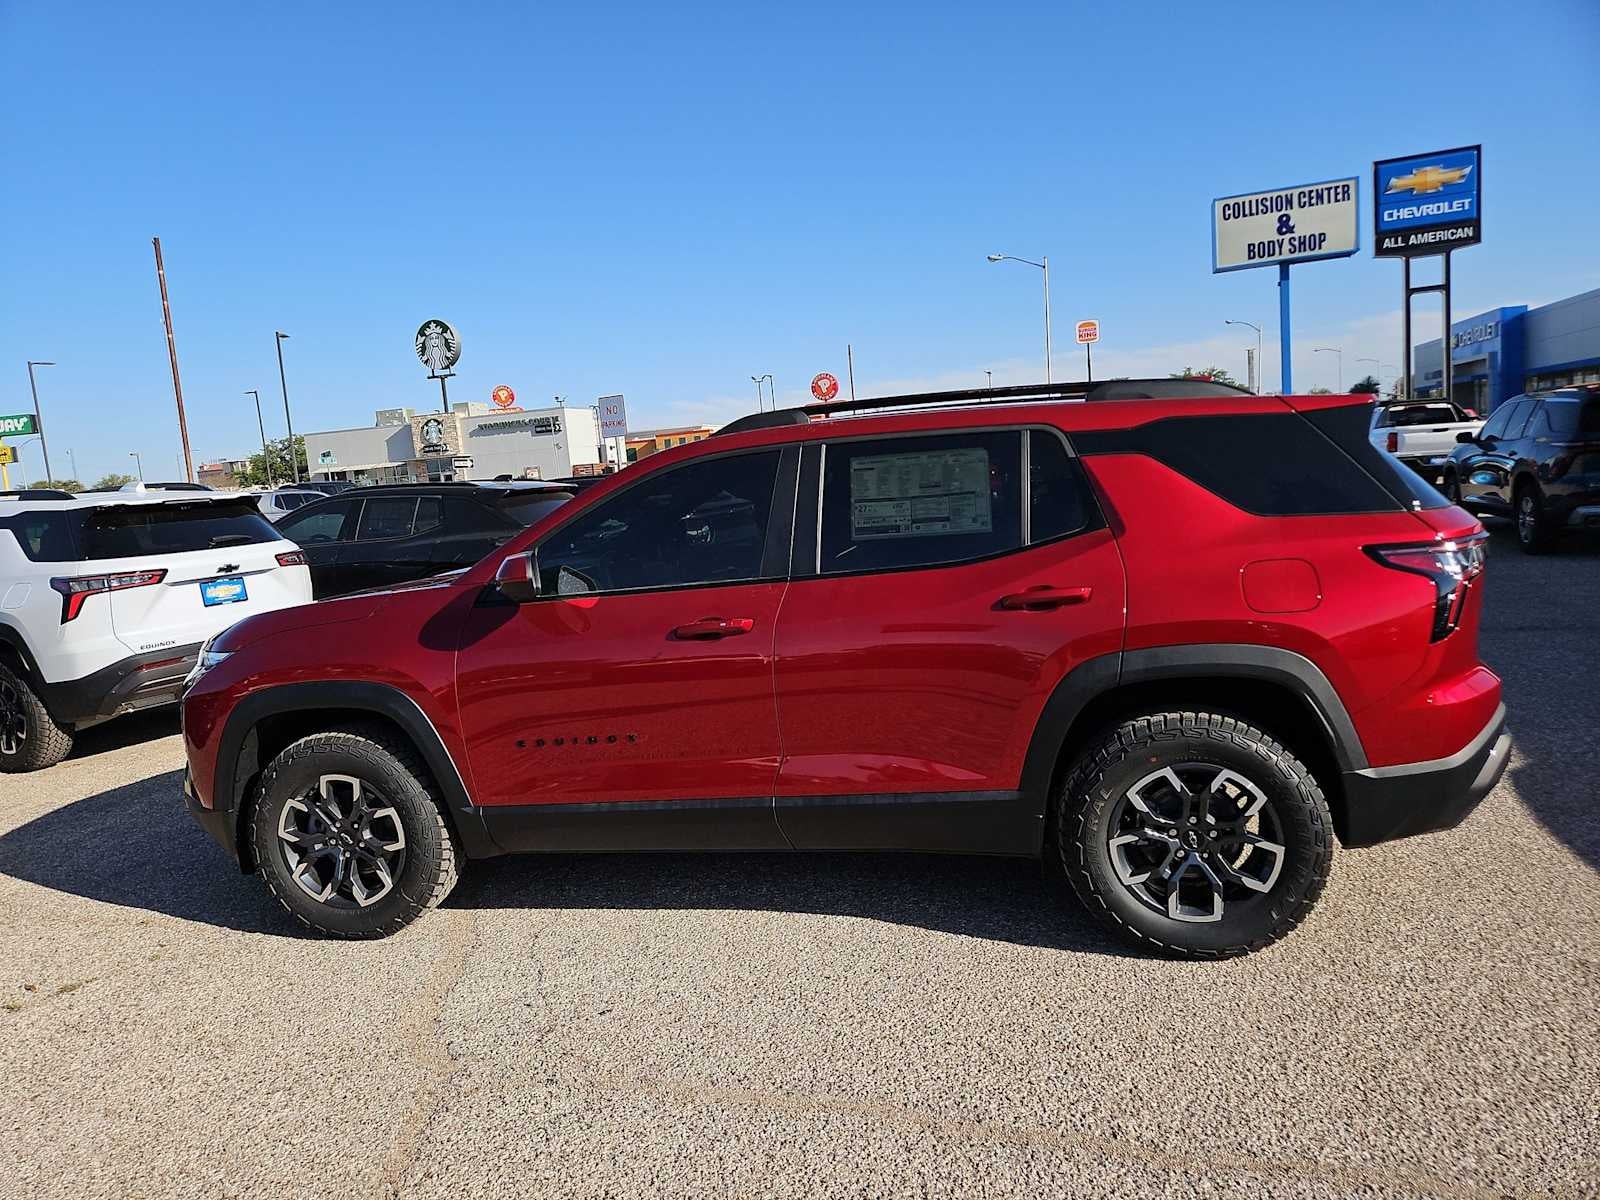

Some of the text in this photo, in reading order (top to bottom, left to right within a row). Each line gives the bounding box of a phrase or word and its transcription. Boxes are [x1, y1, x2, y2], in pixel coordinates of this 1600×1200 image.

[1222, 184, 1351, 221] COLLISION CENTER
[1384, 199, 1472, 222] CHEVROLET
[1276, 213, 1296, 236] &
[1247, 232, 1327, 261] BODY SHOP
[1383, 226, 1473, 249] ALL AMERICAN
[606, 405, 618, 415] NO
[602, 420, 625, 429] PARKING
[139, 640, 176, 650] EQUINOX
[516, 733, 637, 748] EQUINOX
